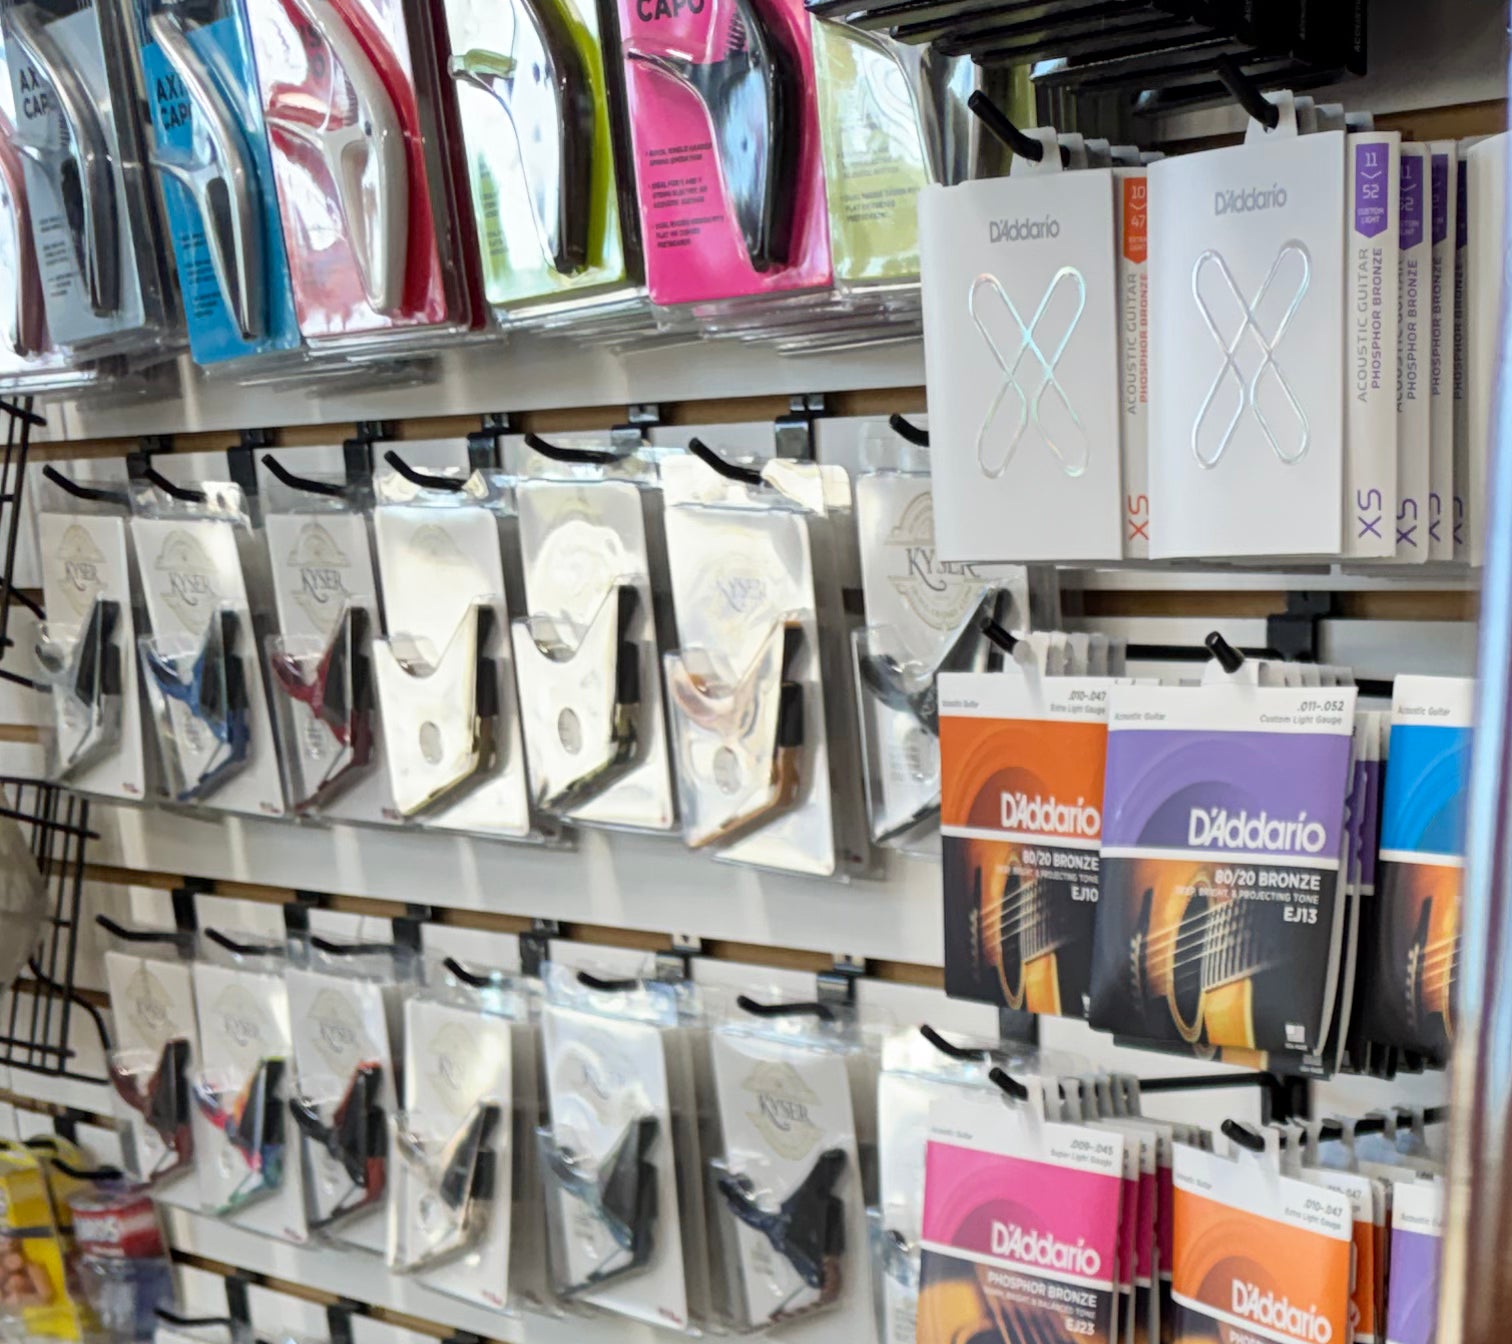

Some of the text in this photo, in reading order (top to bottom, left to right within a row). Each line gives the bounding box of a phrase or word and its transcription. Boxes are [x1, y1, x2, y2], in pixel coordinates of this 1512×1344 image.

[1357, 248, 1370, 403] ACOUSTIC GUITAR
[1358, 487, 1382, 539] XS
[1053, 853, 1099, 871] BRONZE
[1215, 869, 1321, 890] 80/20 BRONZE
[1071, 886, 1098, 902] EJ10
[1283, 906, 1318, 924] EJ13
[987, 1271, 1097, 1308] PHOSPHOR BRONZE
[1065, 1318, 1095, 1336] EJ23
